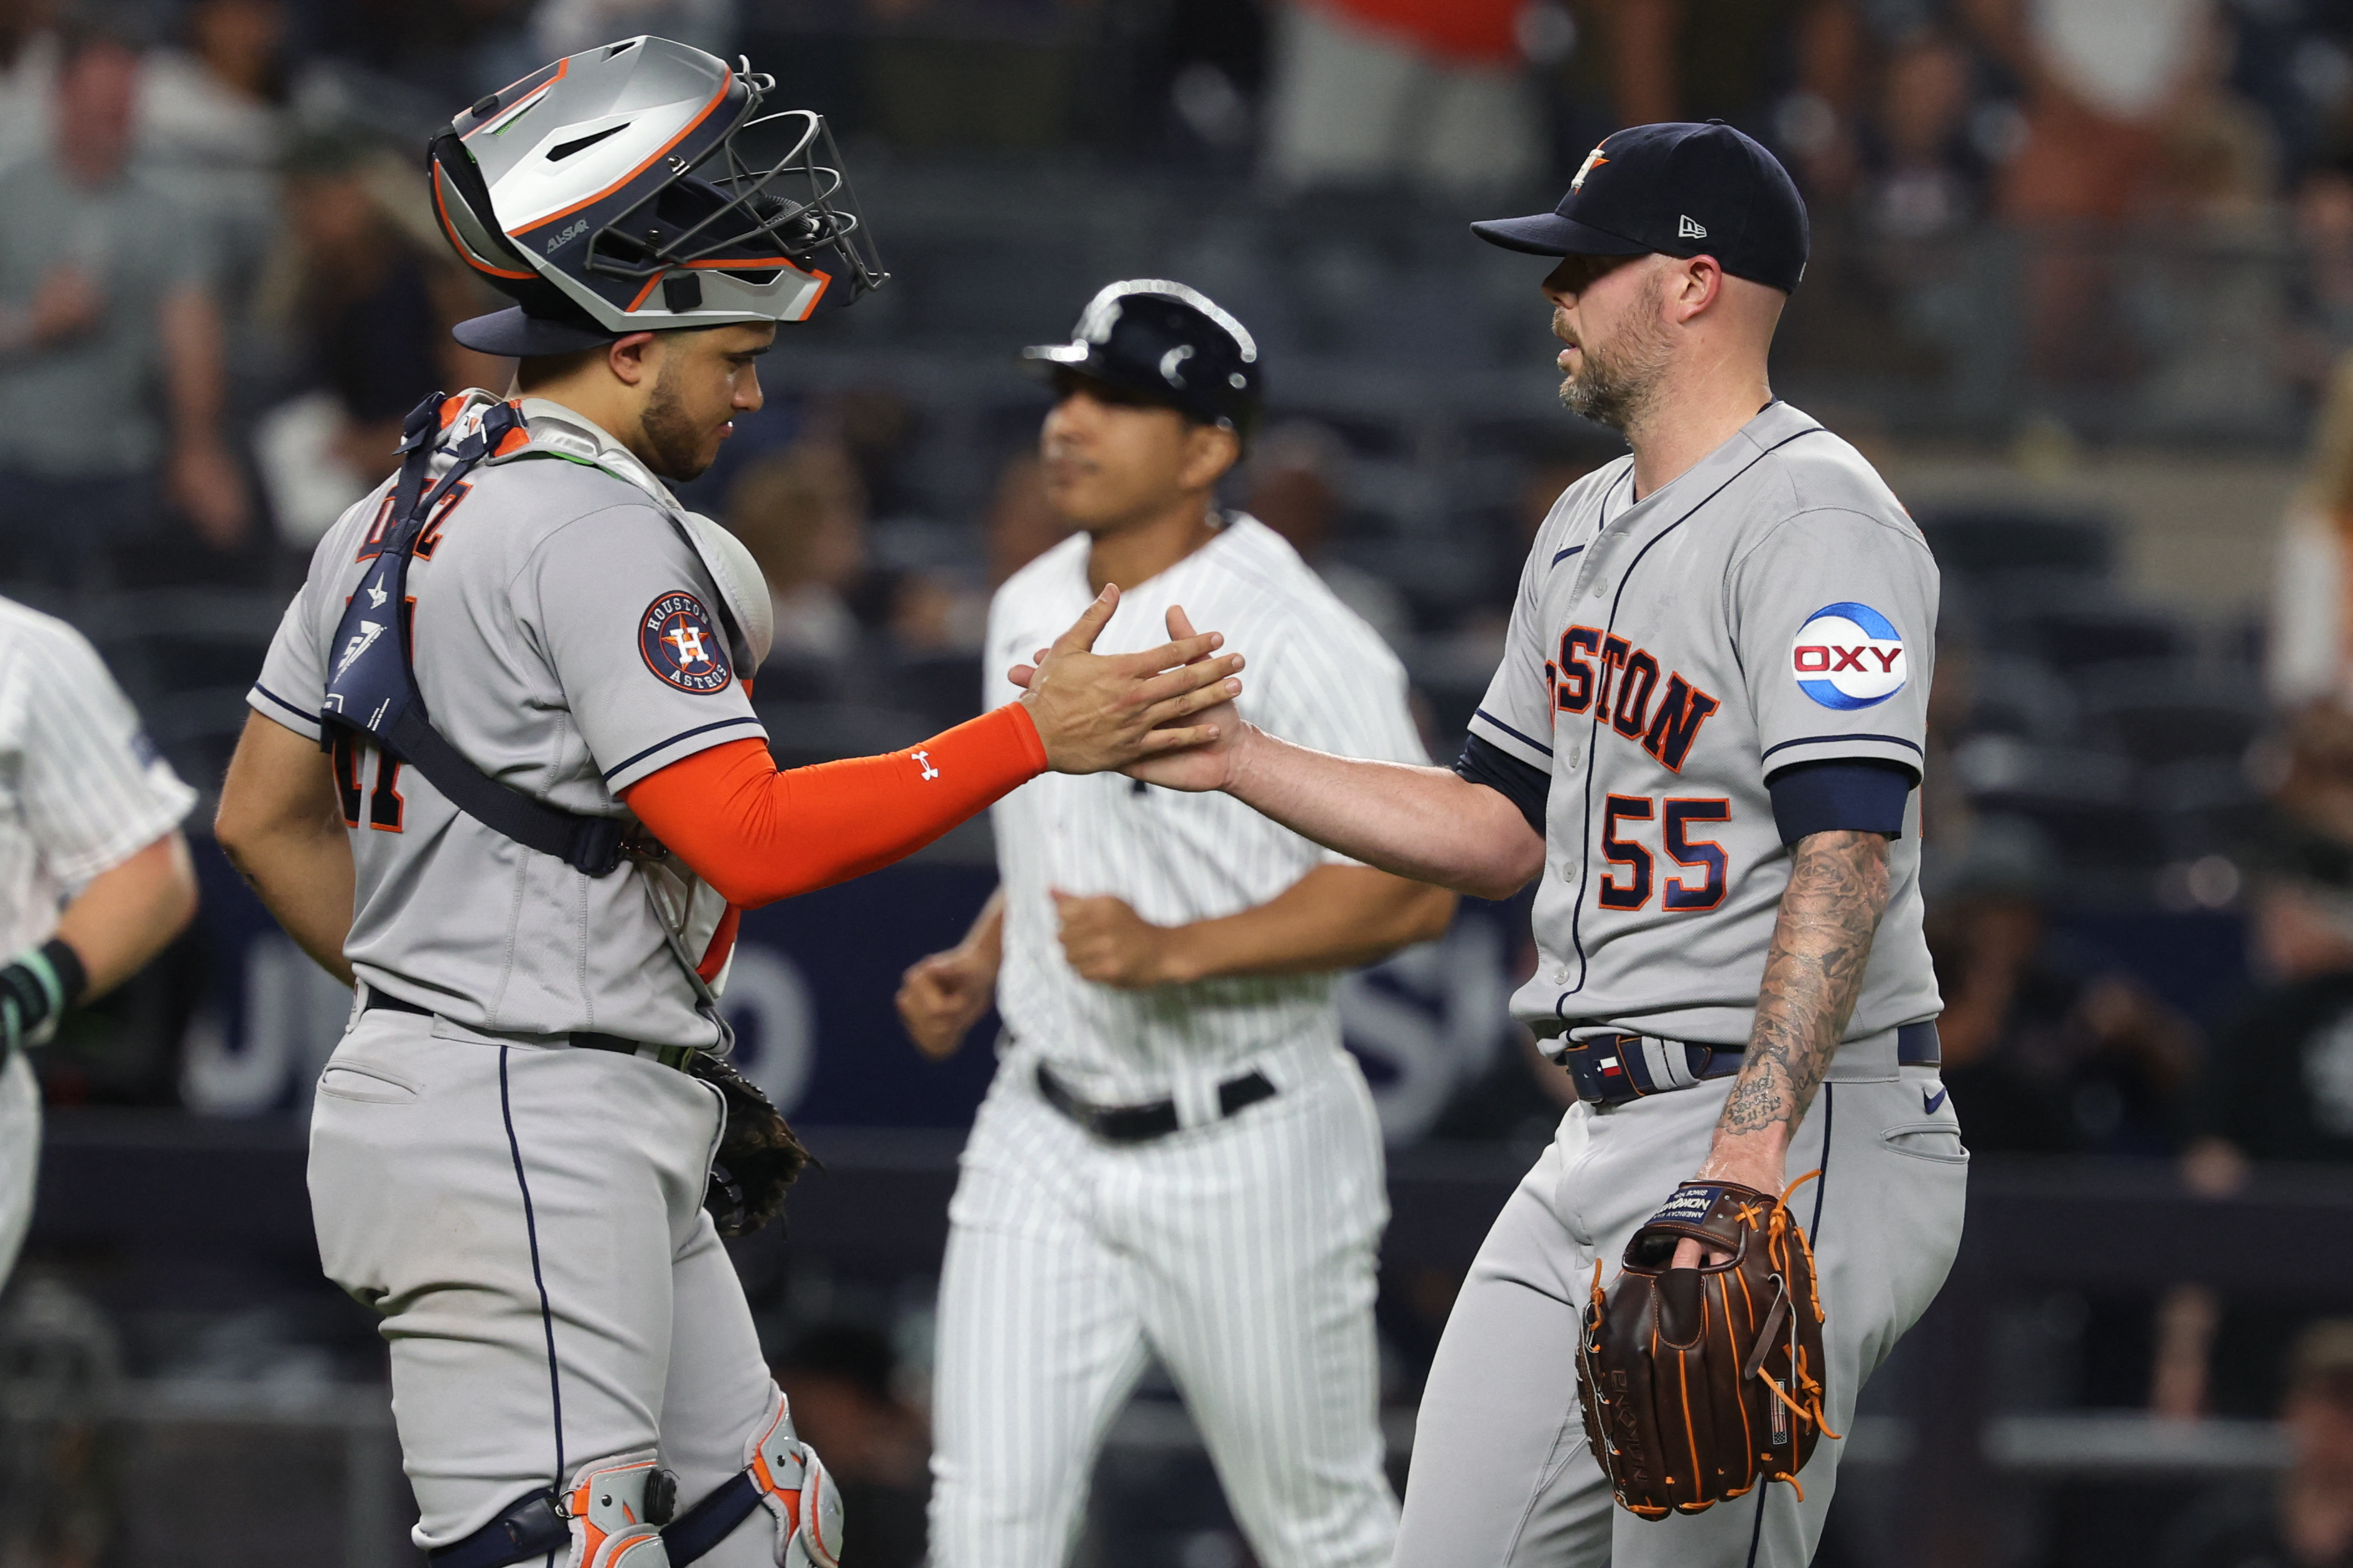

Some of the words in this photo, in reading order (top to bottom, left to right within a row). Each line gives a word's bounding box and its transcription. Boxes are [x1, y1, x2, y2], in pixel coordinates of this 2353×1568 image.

[669, 626, 709, 664] H
[1794, 646, 1903, 672] OXY
[669, 664, 727, 689] ASTROS
[1598, 792, 1731, 912] 55
